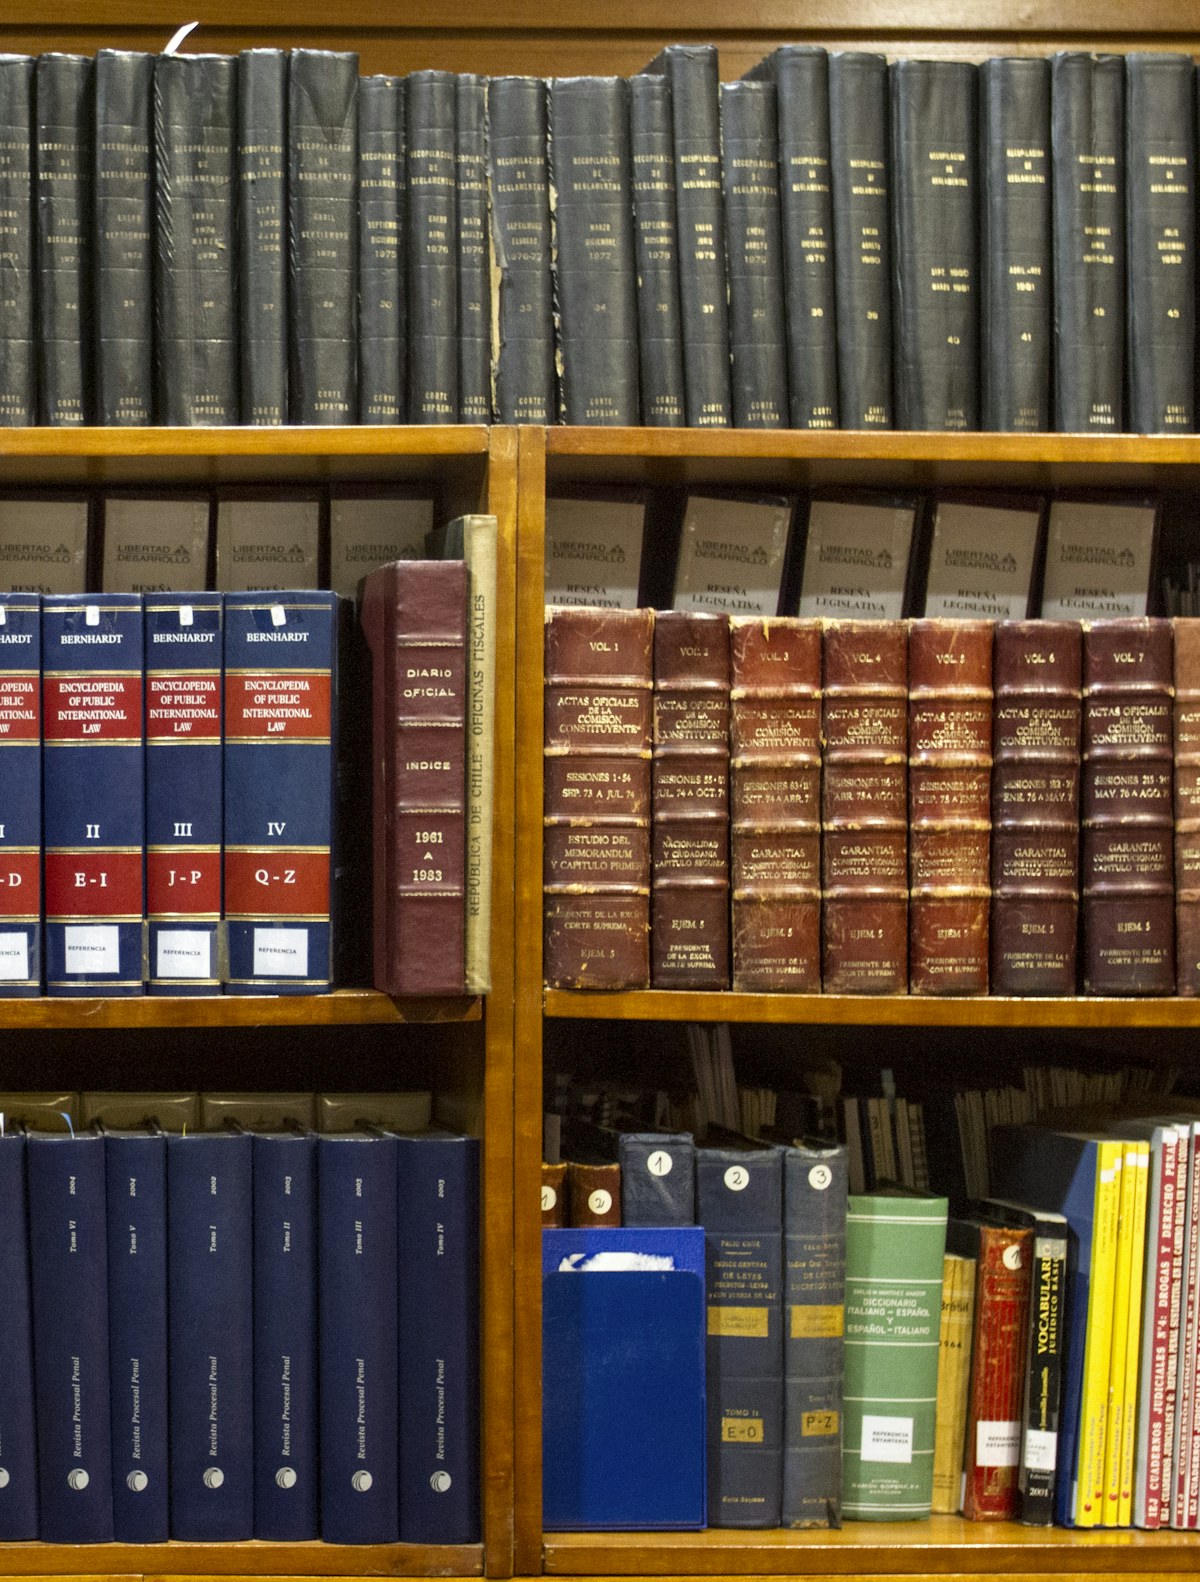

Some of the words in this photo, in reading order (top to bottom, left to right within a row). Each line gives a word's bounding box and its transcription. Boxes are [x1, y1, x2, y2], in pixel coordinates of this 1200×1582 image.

[60, 634, 123, 645] BERNHARDT
[153, 633, 215, 644] BERNHARDT
[246, 631, 310, 643] BERNHARDT
[407, 669, 453, 678] DIARIO
[59, 682, 125, 694] ENCYCLOPEDIA
[150, 681, 217, 693] ENCYCLOPEDIA
[243, 680, 311, 692] ENCYCLOPEDIA
[404, 688, 456, 698] OFICIAL
[69, 696, 81, 707] OF
[84, 696, 116, 708] PUBLIC
[160, 694, 173, 706] OF
[176, 694, 207, 707] PUBLIC
[253, 693, 266, 705] OF
[269, 693, 301, 706] PUBLIC
[473, 670, 485, 738] OFICINAS
[558, 697, 589, 706] ACTAS
[592, 697, 639, 708] OFICIALES
[57, 709, 127, 722] INTERNATIONAL
[149, 708, 218, 720] INTERNATIONAL
[242, 707, 312, 720] INTERNATIONAL
[82, 723, 102, 735] LAW
[173, 722, 193, 734] LAW
[267, 721, 287, 733] LAW
[406, 761, 451, 771] INDICE
[472, 755, 484, 801] CHILE
[566, 773, 610, 782] SESIONES
[596, 790, 603, 798] A
[472, 810, 483, 825] DE
[86, 824, 100, 838] II
[173, 822, 193, 837] III
[267, 822, 286, 836] IV
[415, 832, 444, 844] 1961
[568, 835, 610, 845] ESTUDIO
[423, 852, 433, 861] A
[564, 849, 633, 859] MEMORANDUM
[412, 870, 443, 882] 1983
[163, 949, 202, 957] REFERENCIA
[258, 946, 298, 955] REFERENCIA
[731, 1171, 743, 1185] 2
[815, 1170, 828, 1184] 3
[1162, 1183, 1175, 1238] DERECHO
[209, 1231, 217, 1252] Tomo
[437, 1234, 445, 1256] Tomo
[1161, 1246, 1171, 1254] Y
[1159, 1261, 1170, 1308] DROGAS
[863, 1298, 917, 1307] DICCIONARIO
[847, 1306, 886, 1316] ITALIANO
[896, 1307, 930, 1317] ESPAÑOL
[887, 1316, 894, 1325] Y
[71, 1357, 80, 1383] Penal
[209, 1356, 218, 1382] Penal
[436, 1359, 445, 1385] Penal
[1153, 1346, 1166, 1415] JUDICIALES
[72, 1384, 82, 1422] Procesal
[209, 1383, 218, 1421] Procesal
[436, 1386, 445, 1424] Procesal
[73, 1424, 82, 1458] Revista
[209, 1422, 218, 1457] Revista
[436, 1425, 445, 1460] Revista
[1150, 1422, 1162, 1491] CUADERNOS
[1029, 1487, 1049, 1496] 2001
[1148, 1498, 1158, 1517] IEJ
